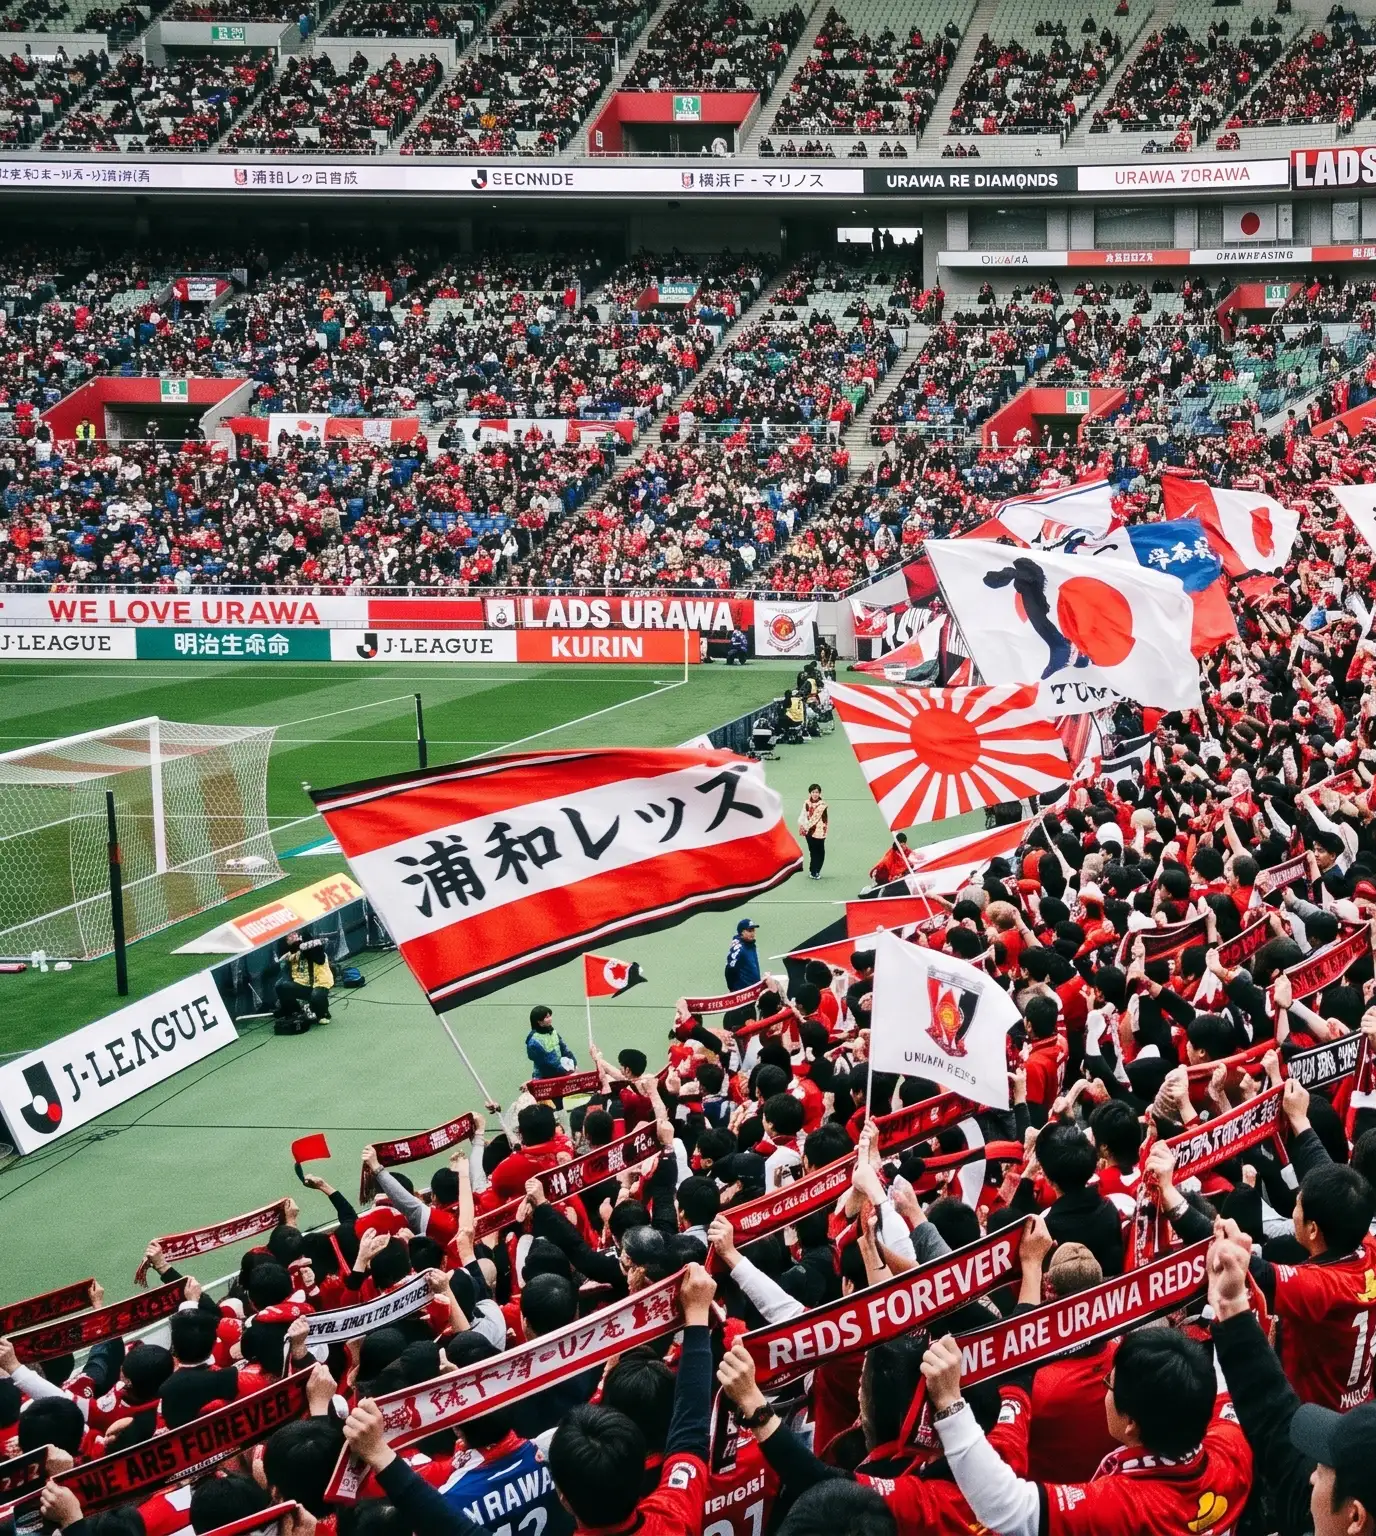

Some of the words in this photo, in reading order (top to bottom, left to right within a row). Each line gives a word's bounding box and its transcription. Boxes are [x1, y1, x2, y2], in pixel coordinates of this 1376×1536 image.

[887, 174, 945, 188] URAWA
[950, 174, 970, 188] RE
[975, 173, 1058, 189] DIAMONDS
[1115, 170, 1175, 185] URAWA
[48, 600, 98, 623] WE
[110, 600, 192, 624] LOVE
[202, 601, 321, 625] URAWA
[523, 599, 609, 628] LADS
[621, 600, 734, 630] URAWA
[551, 636, 643, 657] KURIN
[769, 1318, 863, 1370] REDS
[867, 1241, 1013, 1337] FOREVER
[1002, 1315, 1052, 1361] ARE
[1057, 1281, 1143, 1340] URAWA
[1148, 1254, 1206, 1299] REDS
[76, 1463, 117, 1500] WE
[179, 1389, 292, 1463] FOREVER
